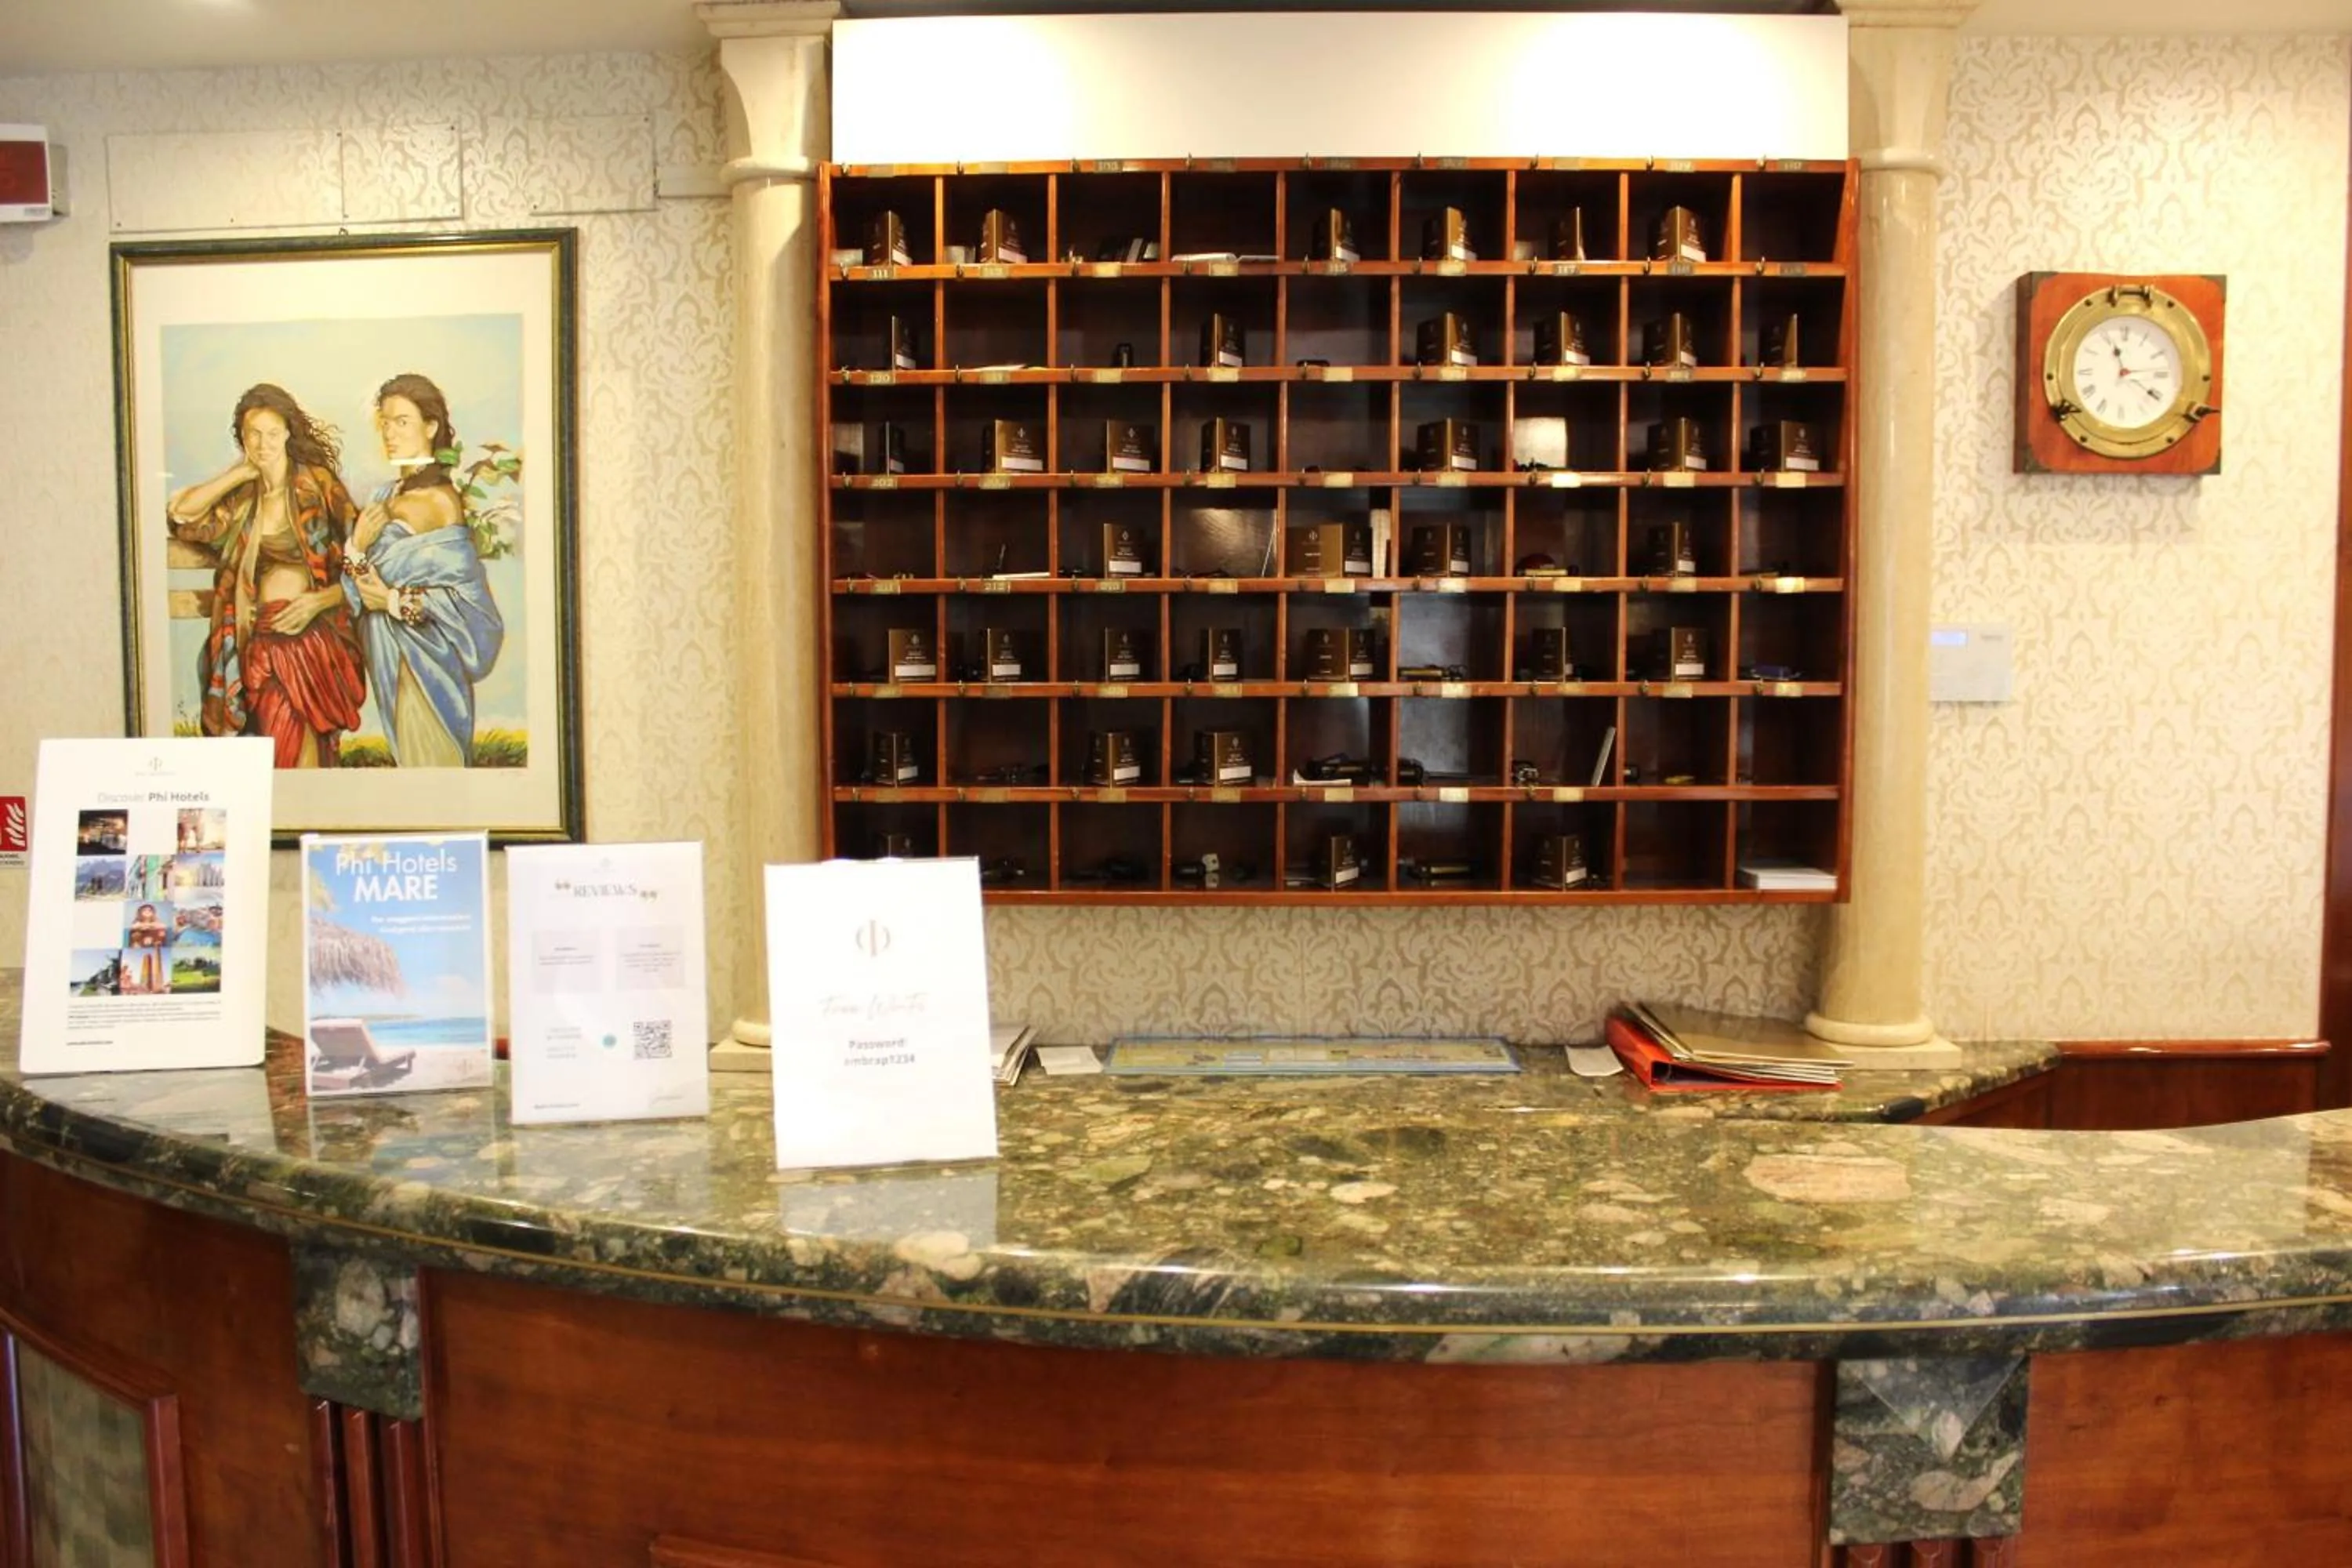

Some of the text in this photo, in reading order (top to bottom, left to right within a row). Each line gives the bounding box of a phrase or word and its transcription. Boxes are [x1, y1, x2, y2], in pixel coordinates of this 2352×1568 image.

[147, 791, 167, 802] Phi
[170, 790, 210, 802] Hotels
[336, 848, 458, 876] Phi Hotels
[354, 874, 438, 902] MARE
